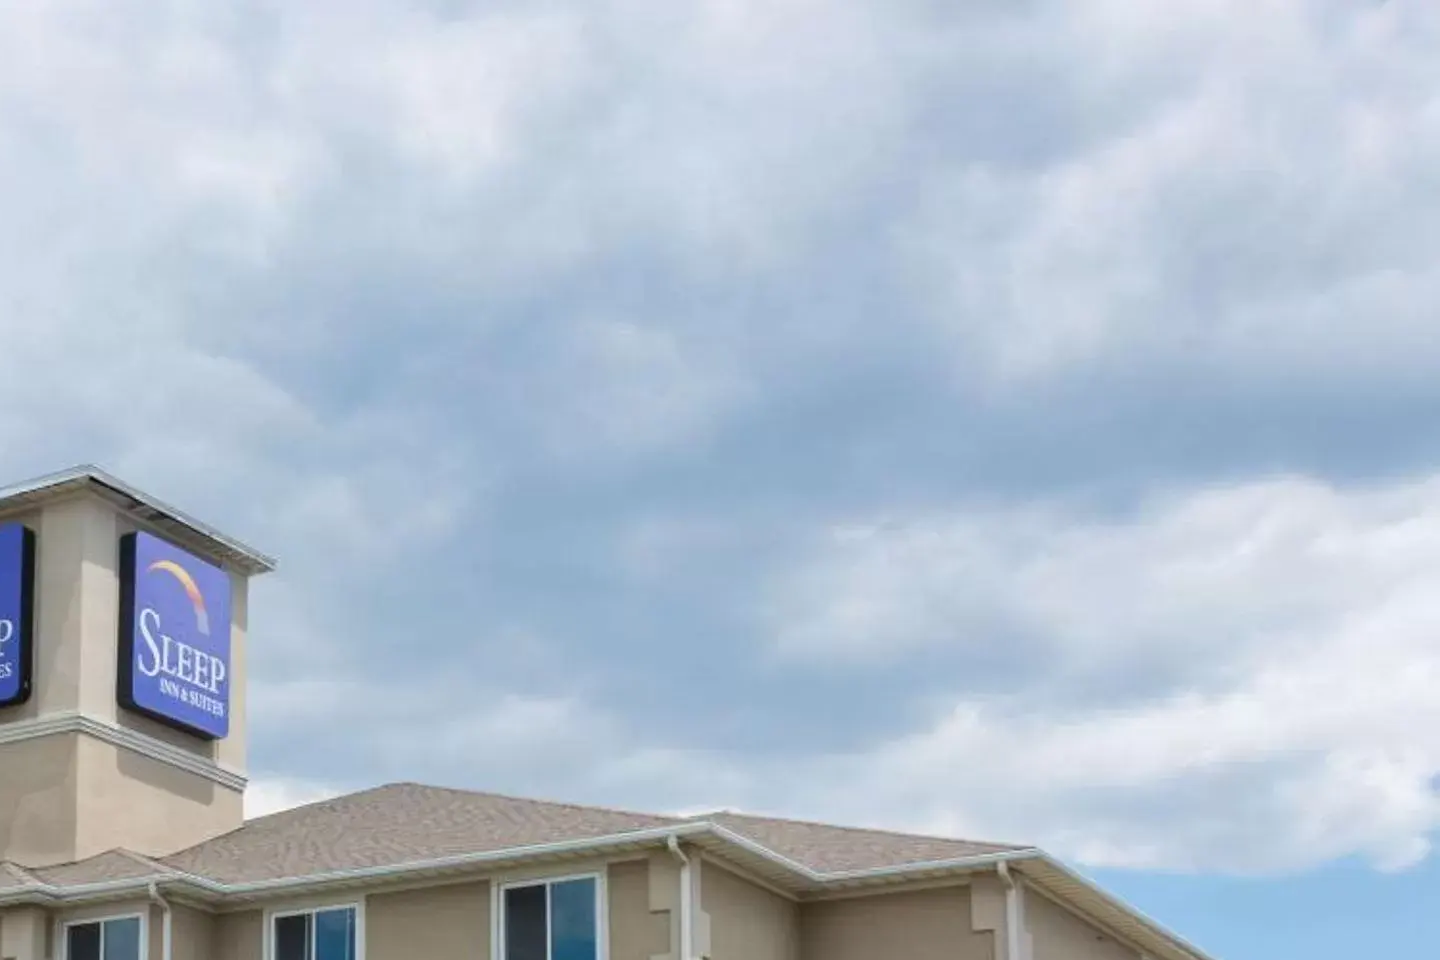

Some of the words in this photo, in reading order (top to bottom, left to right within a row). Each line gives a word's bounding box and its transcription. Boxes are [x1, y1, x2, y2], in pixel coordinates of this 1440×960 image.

[138, 608, 225, 694] SLEEP
[160, 678, 179, 700] INN
[180, 688, 188, 702] &
[189, 691, 224, 717] SUITES
